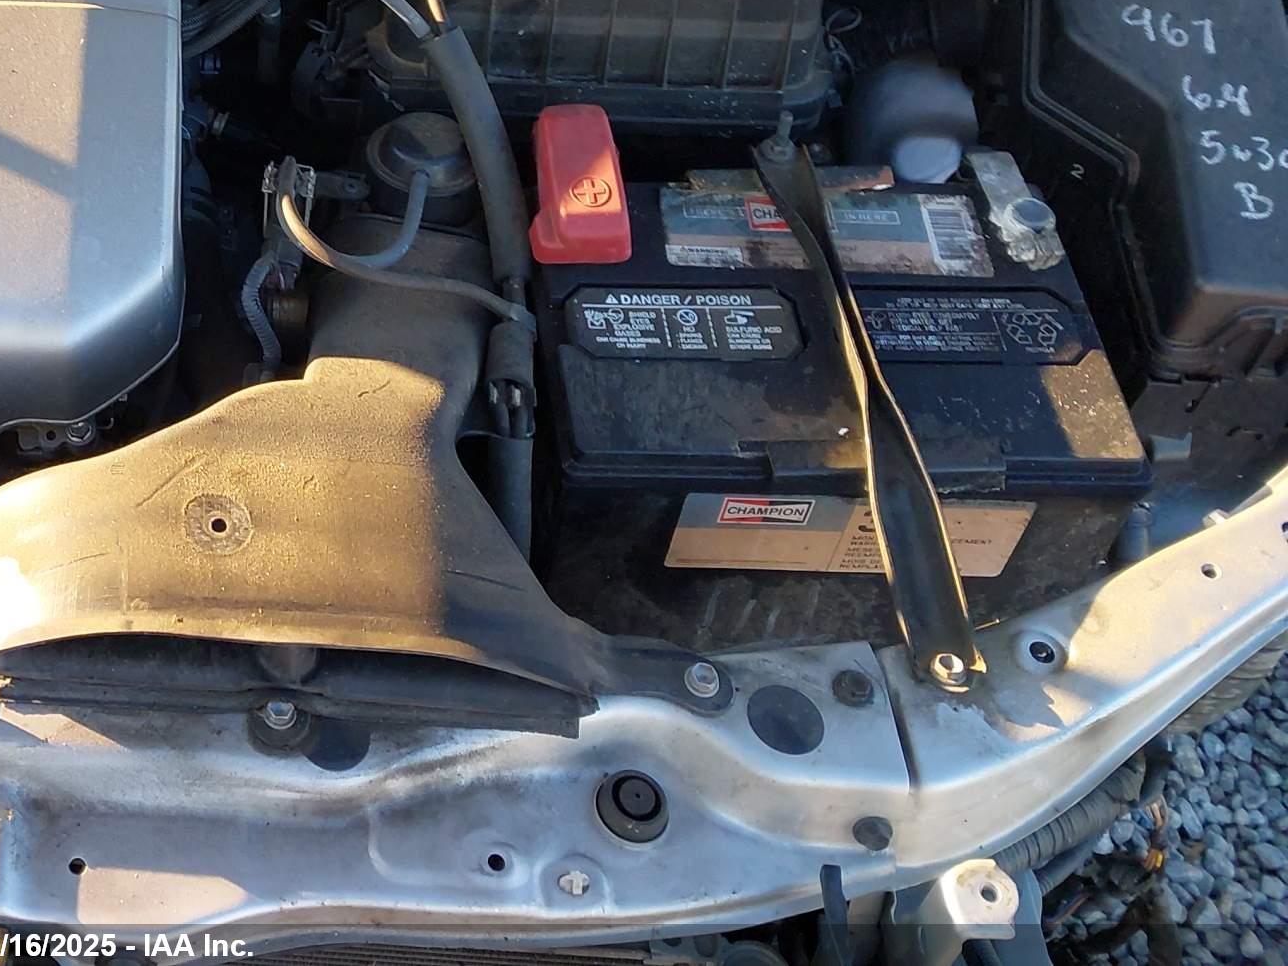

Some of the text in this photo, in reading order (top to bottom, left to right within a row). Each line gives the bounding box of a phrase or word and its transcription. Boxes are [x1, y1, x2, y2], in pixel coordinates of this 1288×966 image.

[1234, 182, 1274, 220] B
[620, 294, 681, 305] DANGER
[695, 295, 752, 306] POISON
[727, 506, 805, 517] CHAMPION
